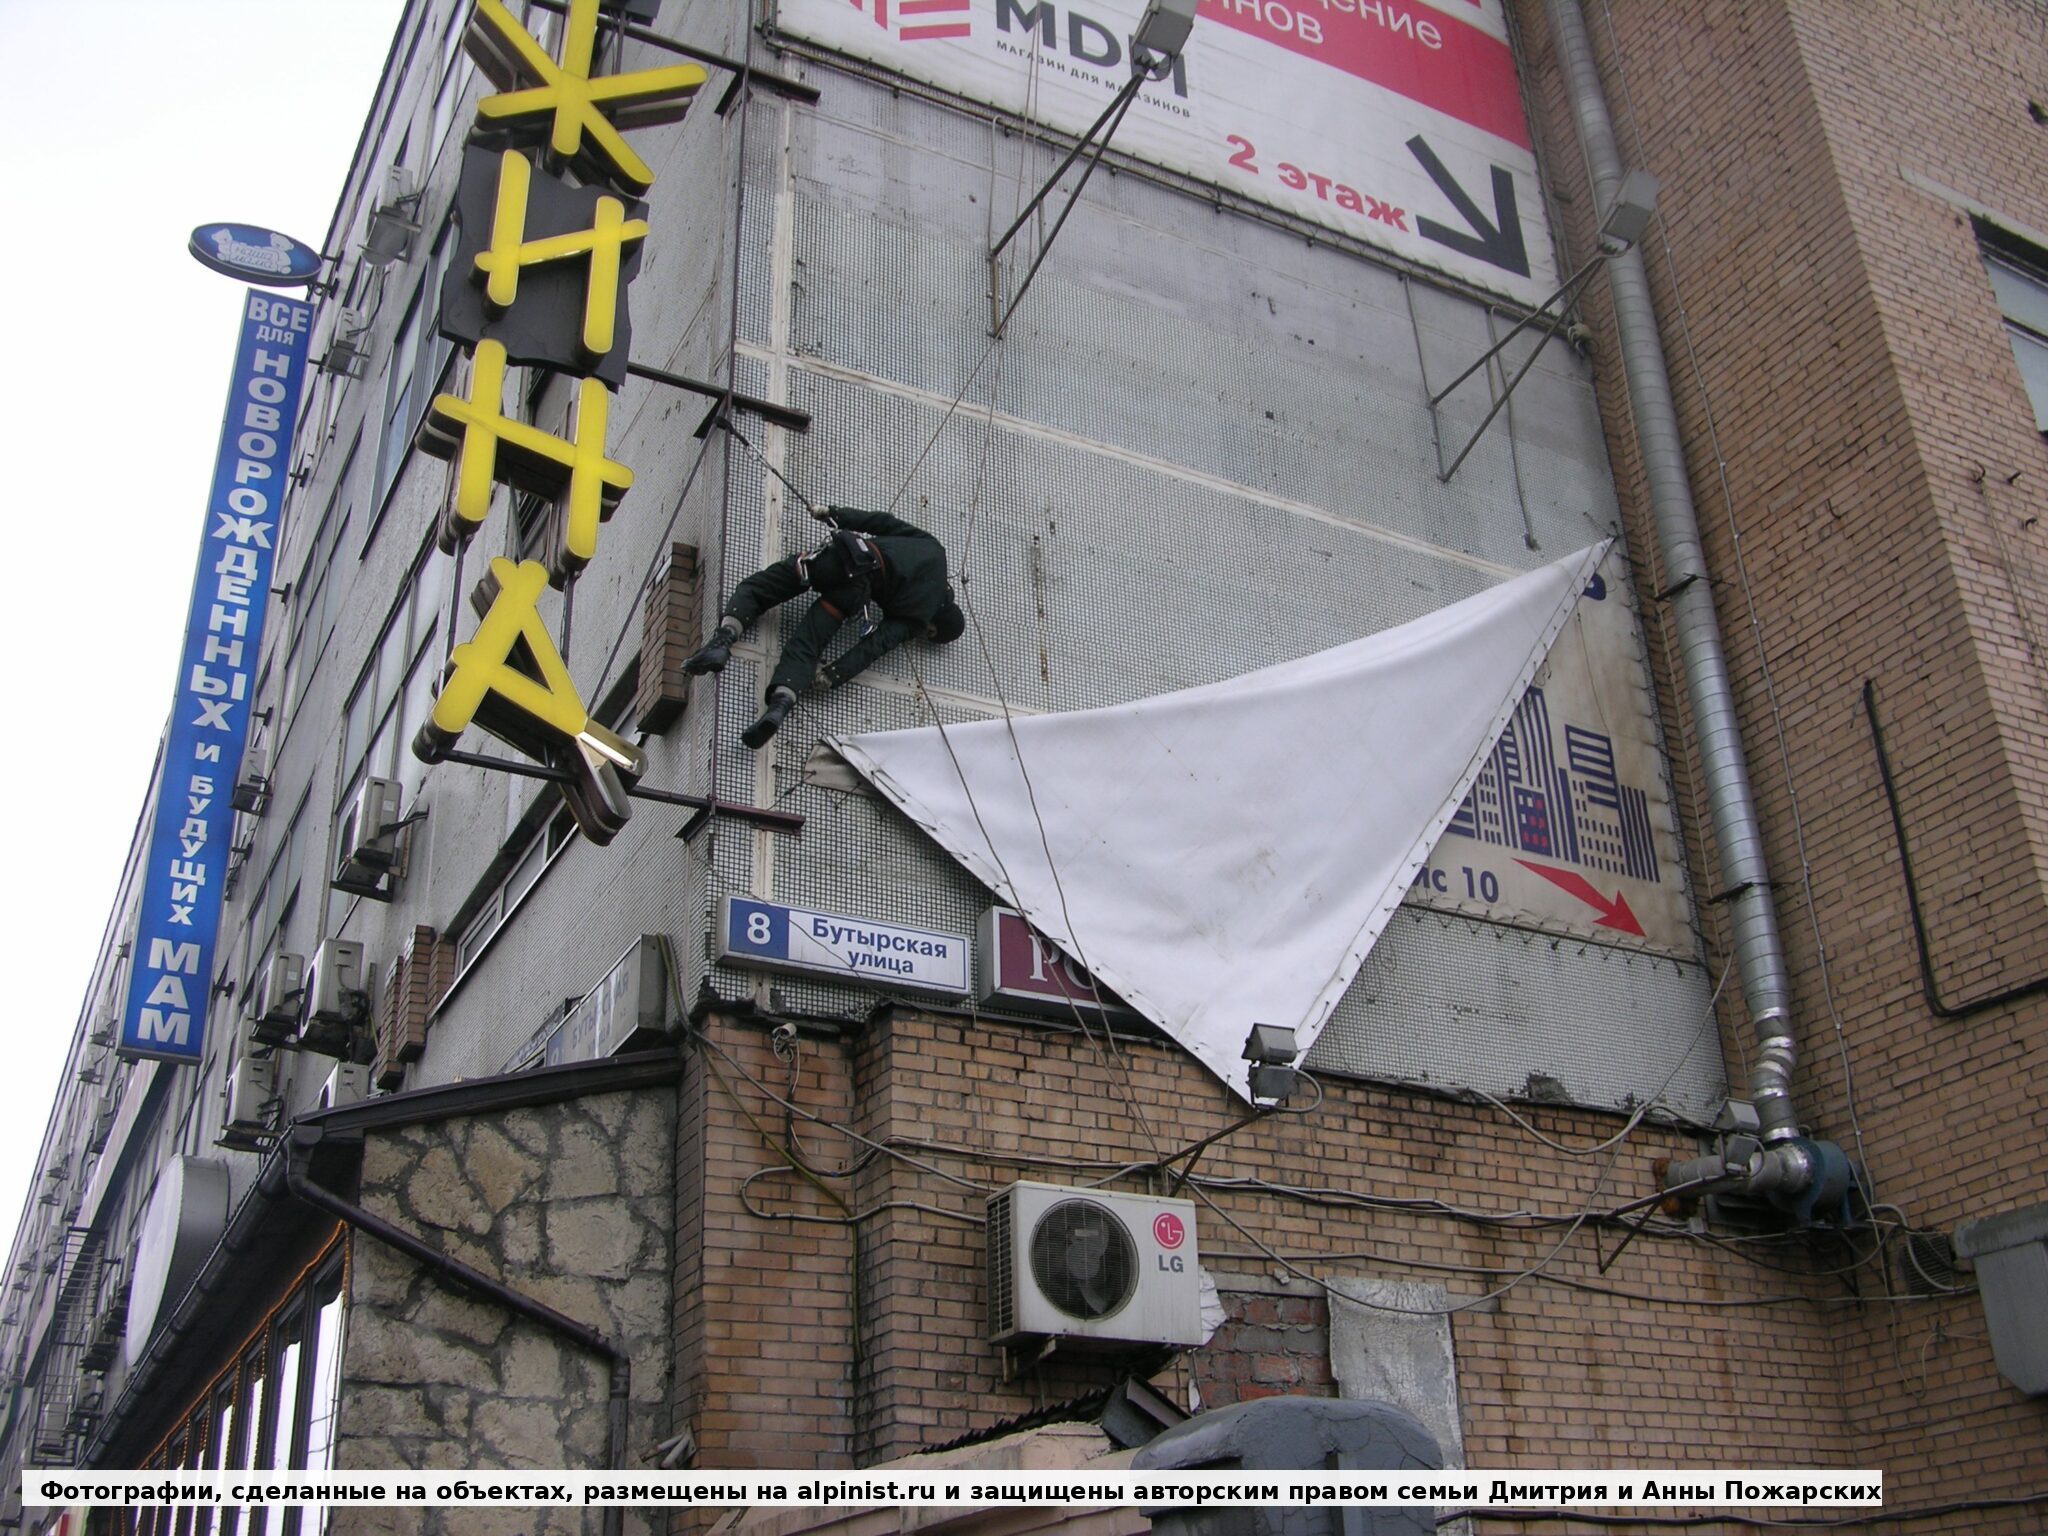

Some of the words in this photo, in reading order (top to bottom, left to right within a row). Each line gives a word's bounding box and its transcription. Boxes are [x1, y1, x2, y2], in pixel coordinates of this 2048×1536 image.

[997, 40, 1065, 72] МАГАЗИН
[1070, 68, 1100, 86] ДЛЯ
[1226, 134, 1259, 174] 2
[1277, 162, 1410, 233] этаж
[247, 296, 310, 333] ВСЕ
[255, 325, 295, 346] ДЛЯ
[190, 348, 290, 732] НОВОРОЖДЕННЫХ
[168, 774, 214, 926] БУДУЩИХ
[1462, 866, 1499, 903] 10
[746, 912, 772, 945] 8
[812, 917, 948, 959] Бутырская
[847, 948, 914, 975] улица
[136, 937, 201, 1046] МАМ
[1158, 1254, 1184, 1273] LG
